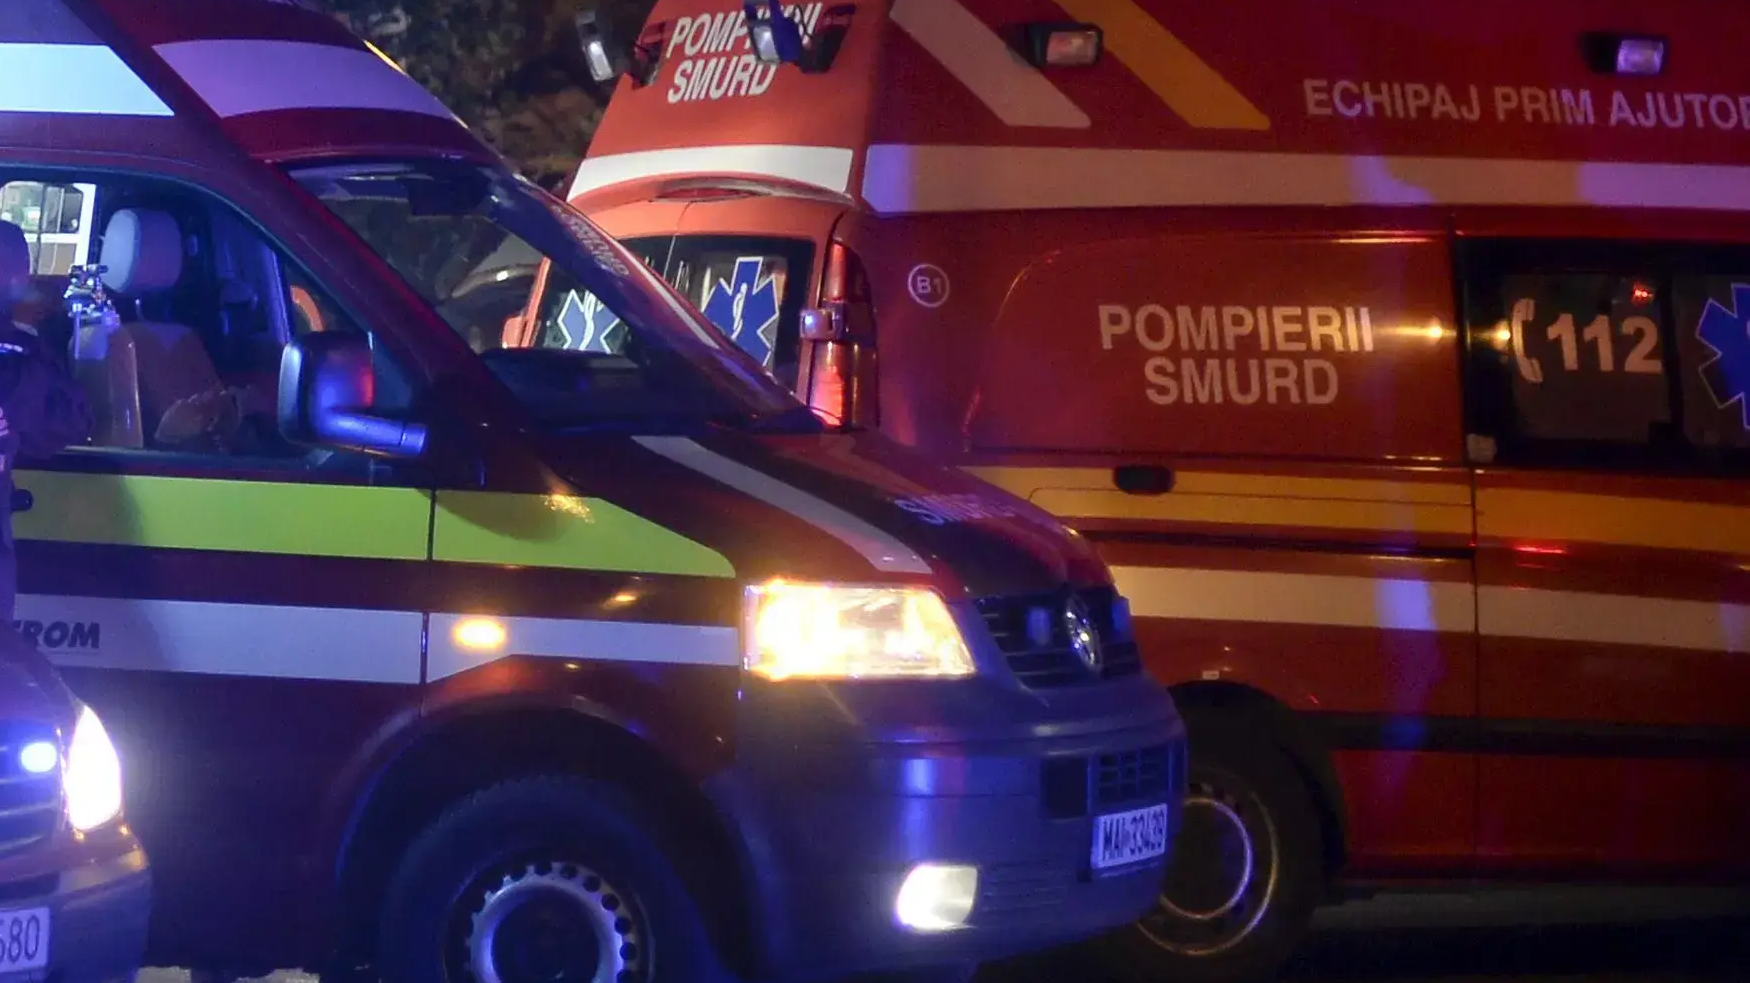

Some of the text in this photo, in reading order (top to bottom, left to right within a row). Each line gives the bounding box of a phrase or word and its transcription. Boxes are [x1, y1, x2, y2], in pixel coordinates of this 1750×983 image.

[666, 54, 778, 104] SMURD
[1303, 78, 1479, 120] ECHIPAJ
[1494, 85, 1594, 126] PRIM
[917, 276, 941, 295] B1
[1099, 304, 1374, 352] POMPIERII
[1547, 313, 1662, 374] 112
[1145, 357, 1338, 405] SMURD
[13, 620, 100, 649] ROM
